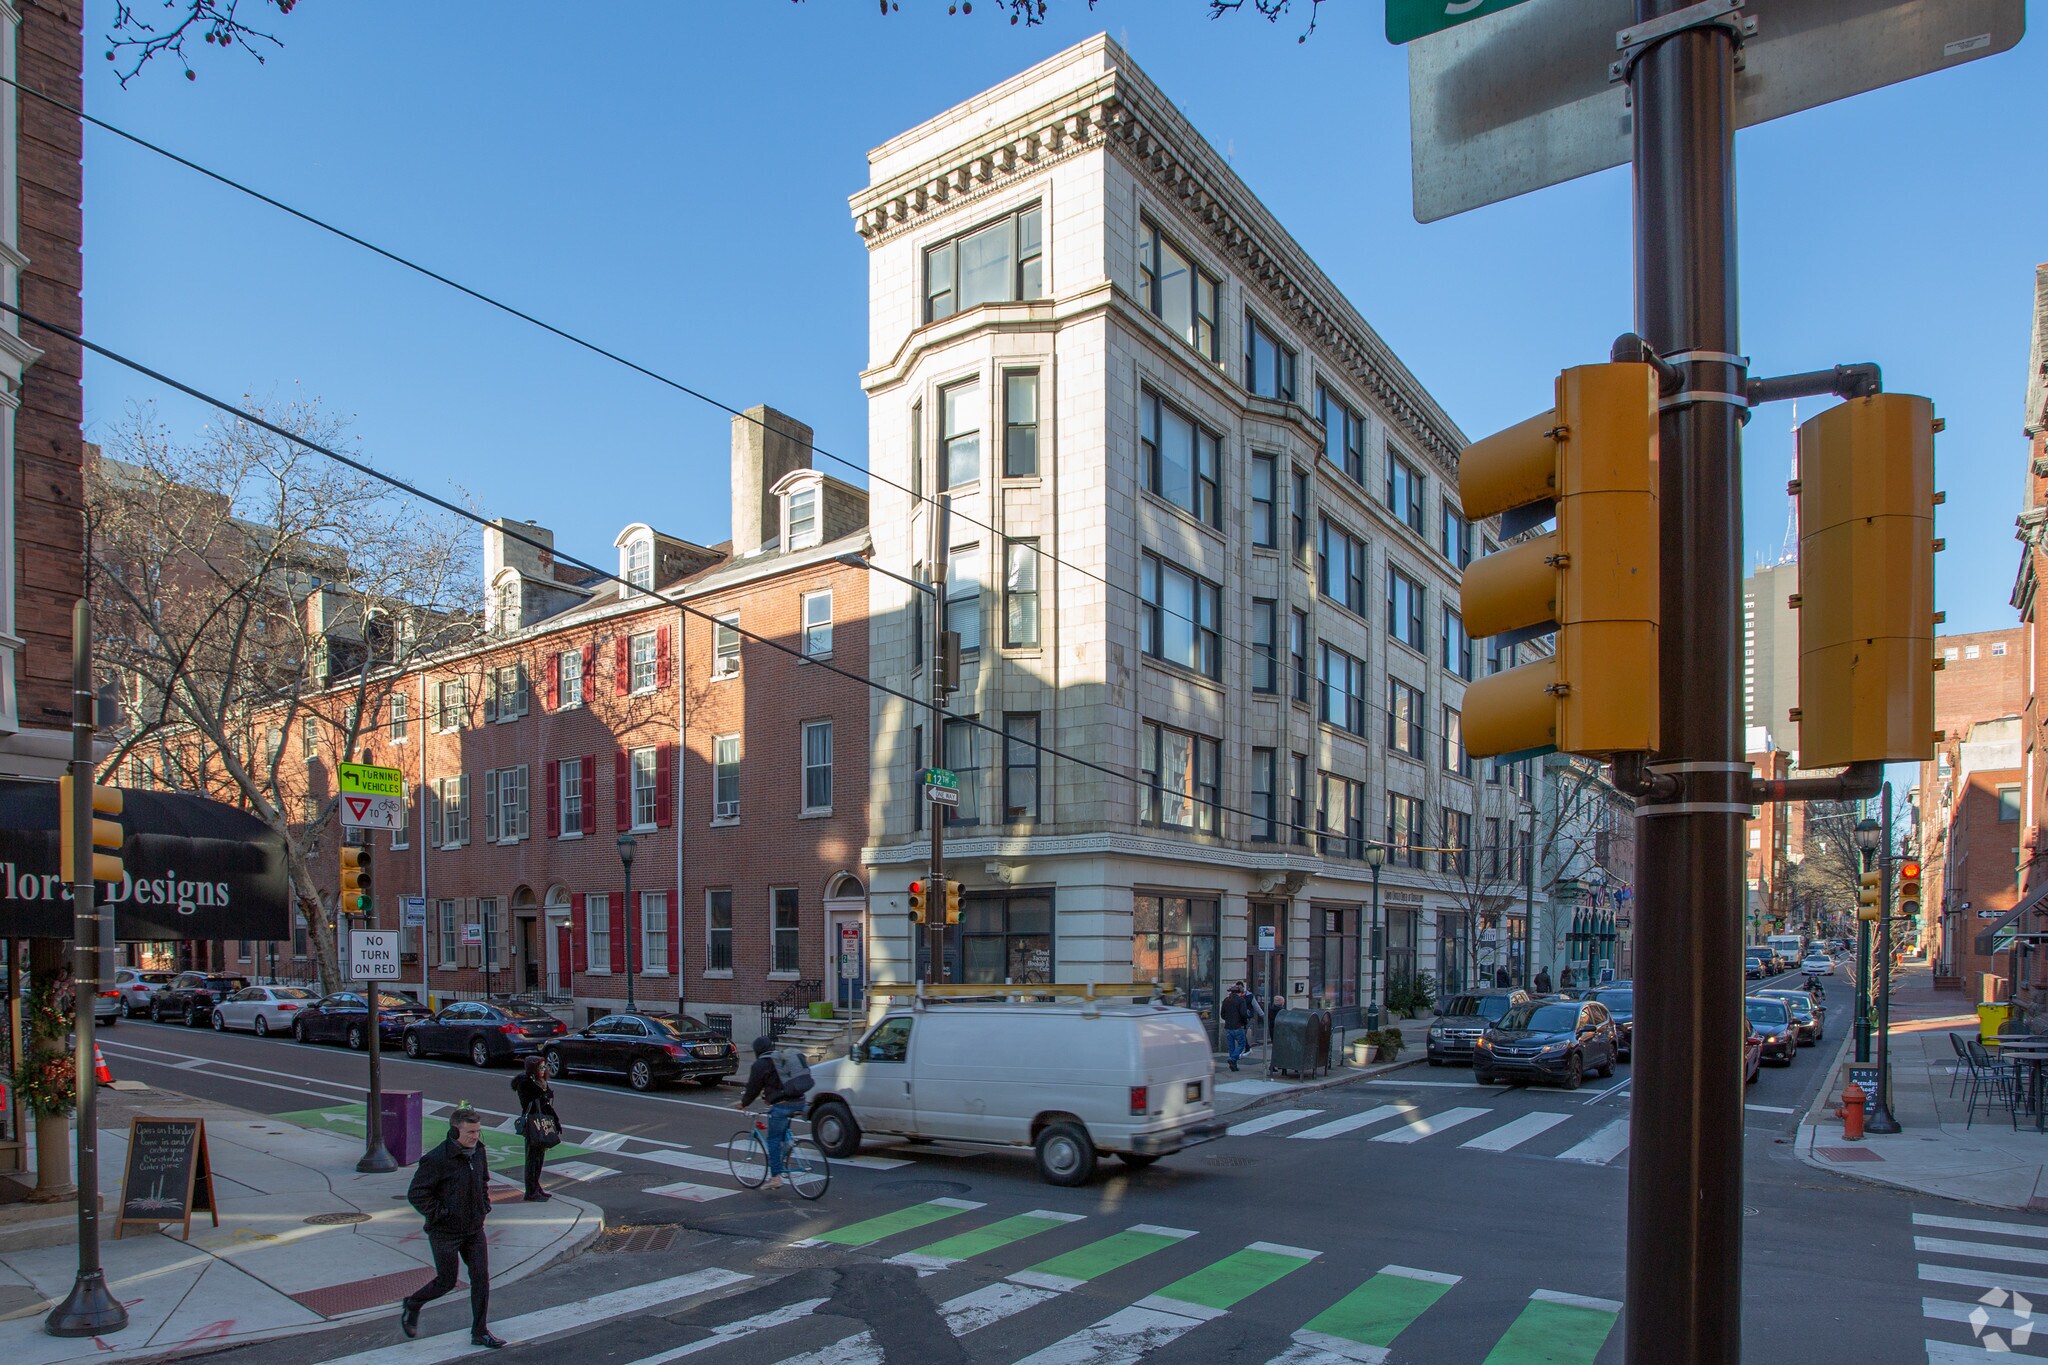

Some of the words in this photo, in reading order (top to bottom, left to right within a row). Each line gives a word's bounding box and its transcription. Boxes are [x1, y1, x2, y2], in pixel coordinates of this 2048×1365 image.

[362, 770, 398, 781] TURNING
[362, 781, 399, 793] VEHICLES
[370, 809, 379, 818] TO
[0, 862, 75, 900] lor
[104, 870, 230, 915] Designs
[366, 936, 383, 945] NO
[361, 950, 389, 960] TURN
[355, 964, 370, 974] ON
[374, 964, 396, 974] RED
